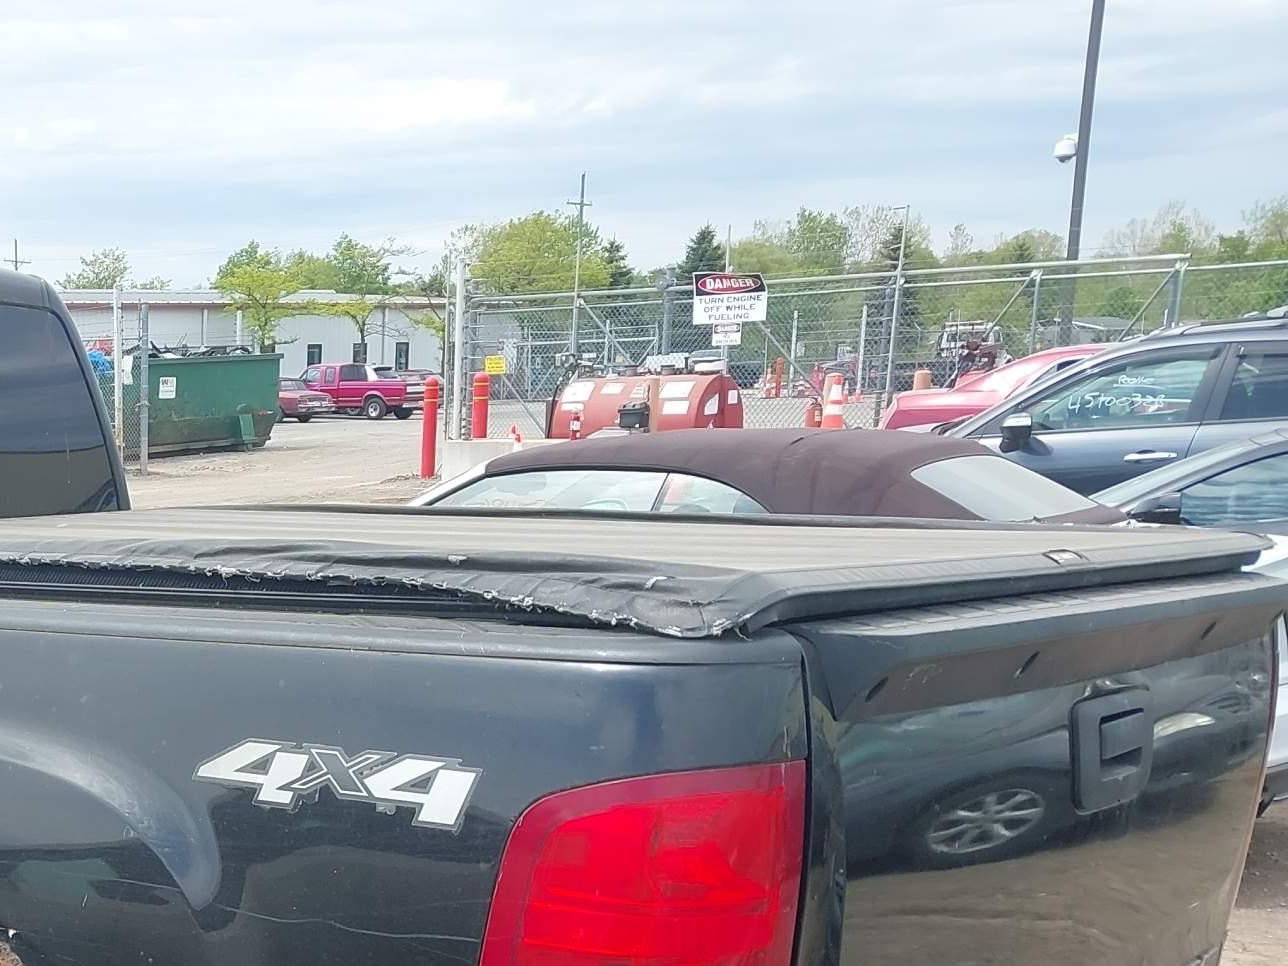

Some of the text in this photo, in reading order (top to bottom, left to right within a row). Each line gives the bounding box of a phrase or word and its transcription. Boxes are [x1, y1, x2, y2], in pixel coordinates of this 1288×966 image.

[705, 278, 755, 290] DANGER
[698, 294, 763, 305] TURN ENGINE
[703, 303, 757, 313] OFF WHILE
[708, 313, 750, 321] FUELING
